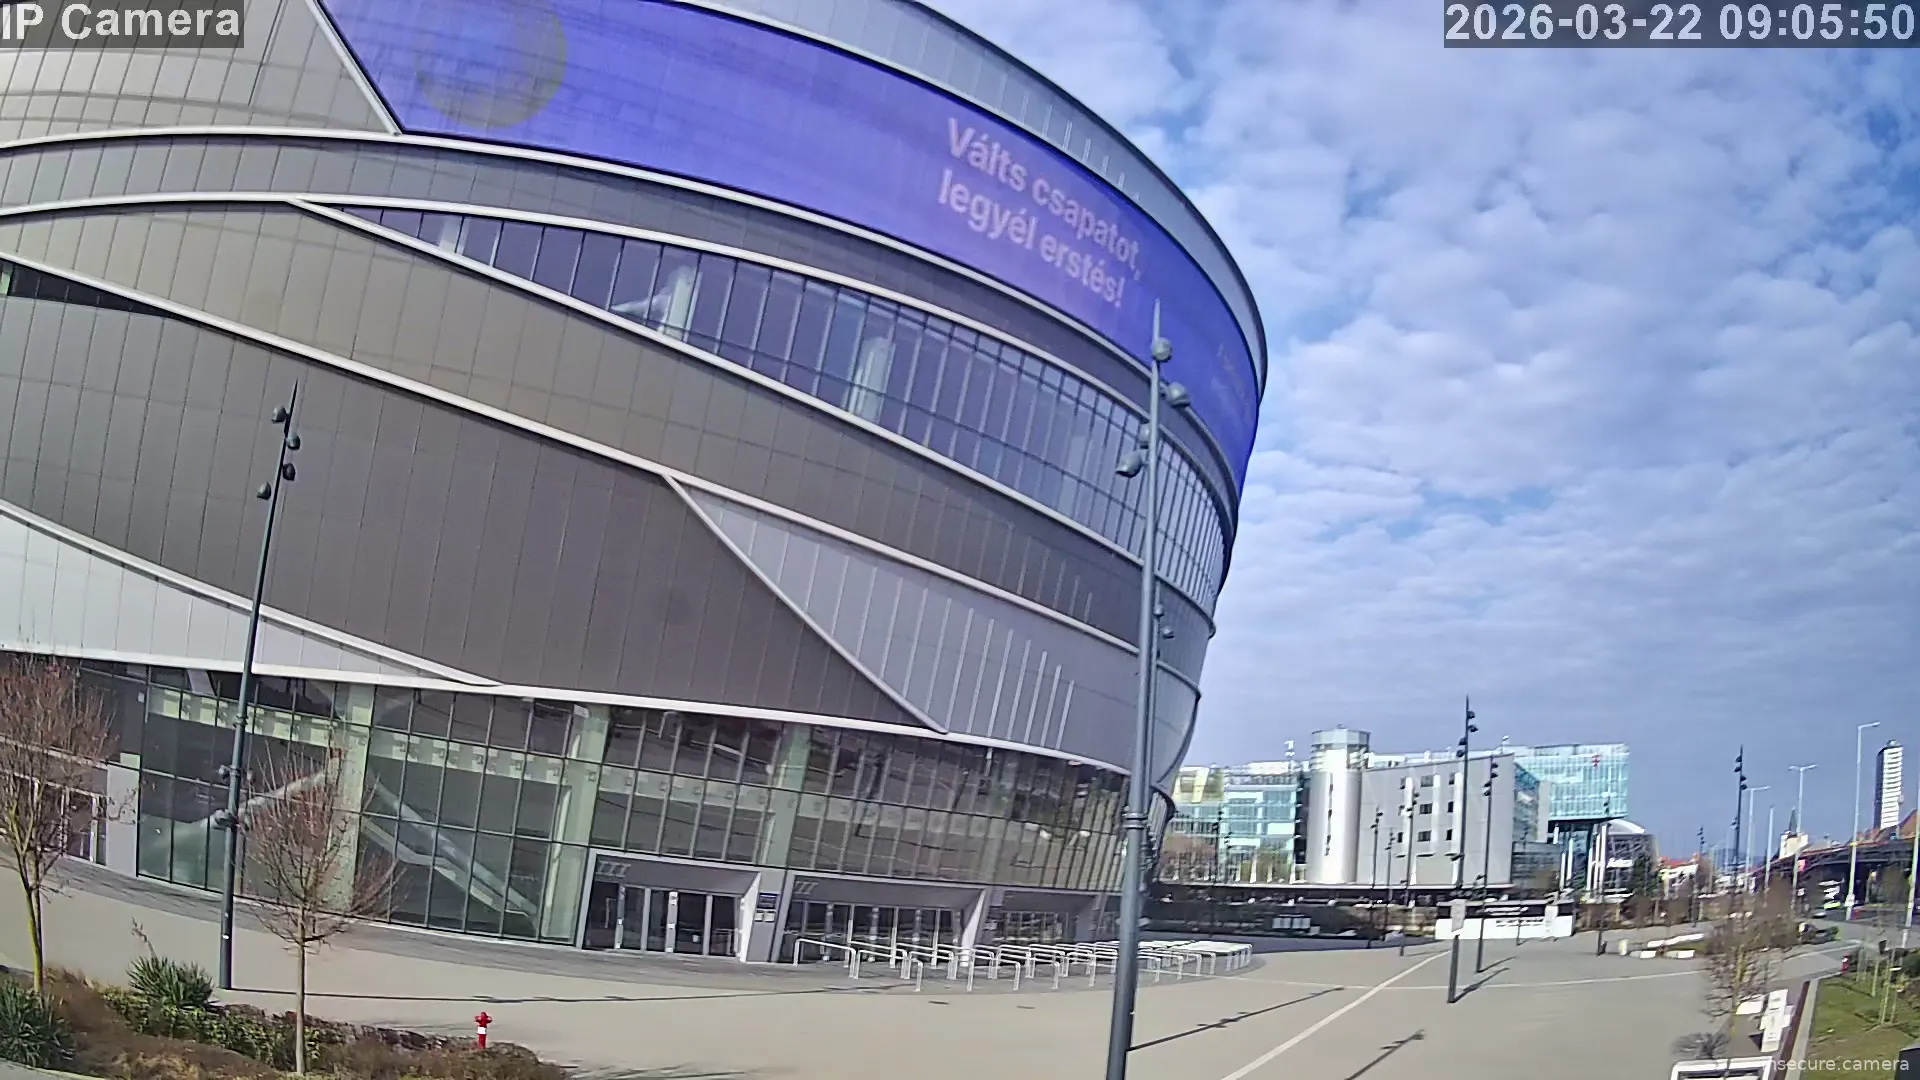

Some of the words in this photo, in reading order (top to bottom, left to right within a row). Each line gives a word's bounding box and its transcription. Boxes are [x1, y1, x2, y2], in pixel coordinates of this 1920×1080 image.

[938, 168, 1037, 250] legyél
[1040, 234, 1125, 309] erstés!
[948, 117, 1028, 192] Válts
[1031, 174, 1142, 281] csapatot,
